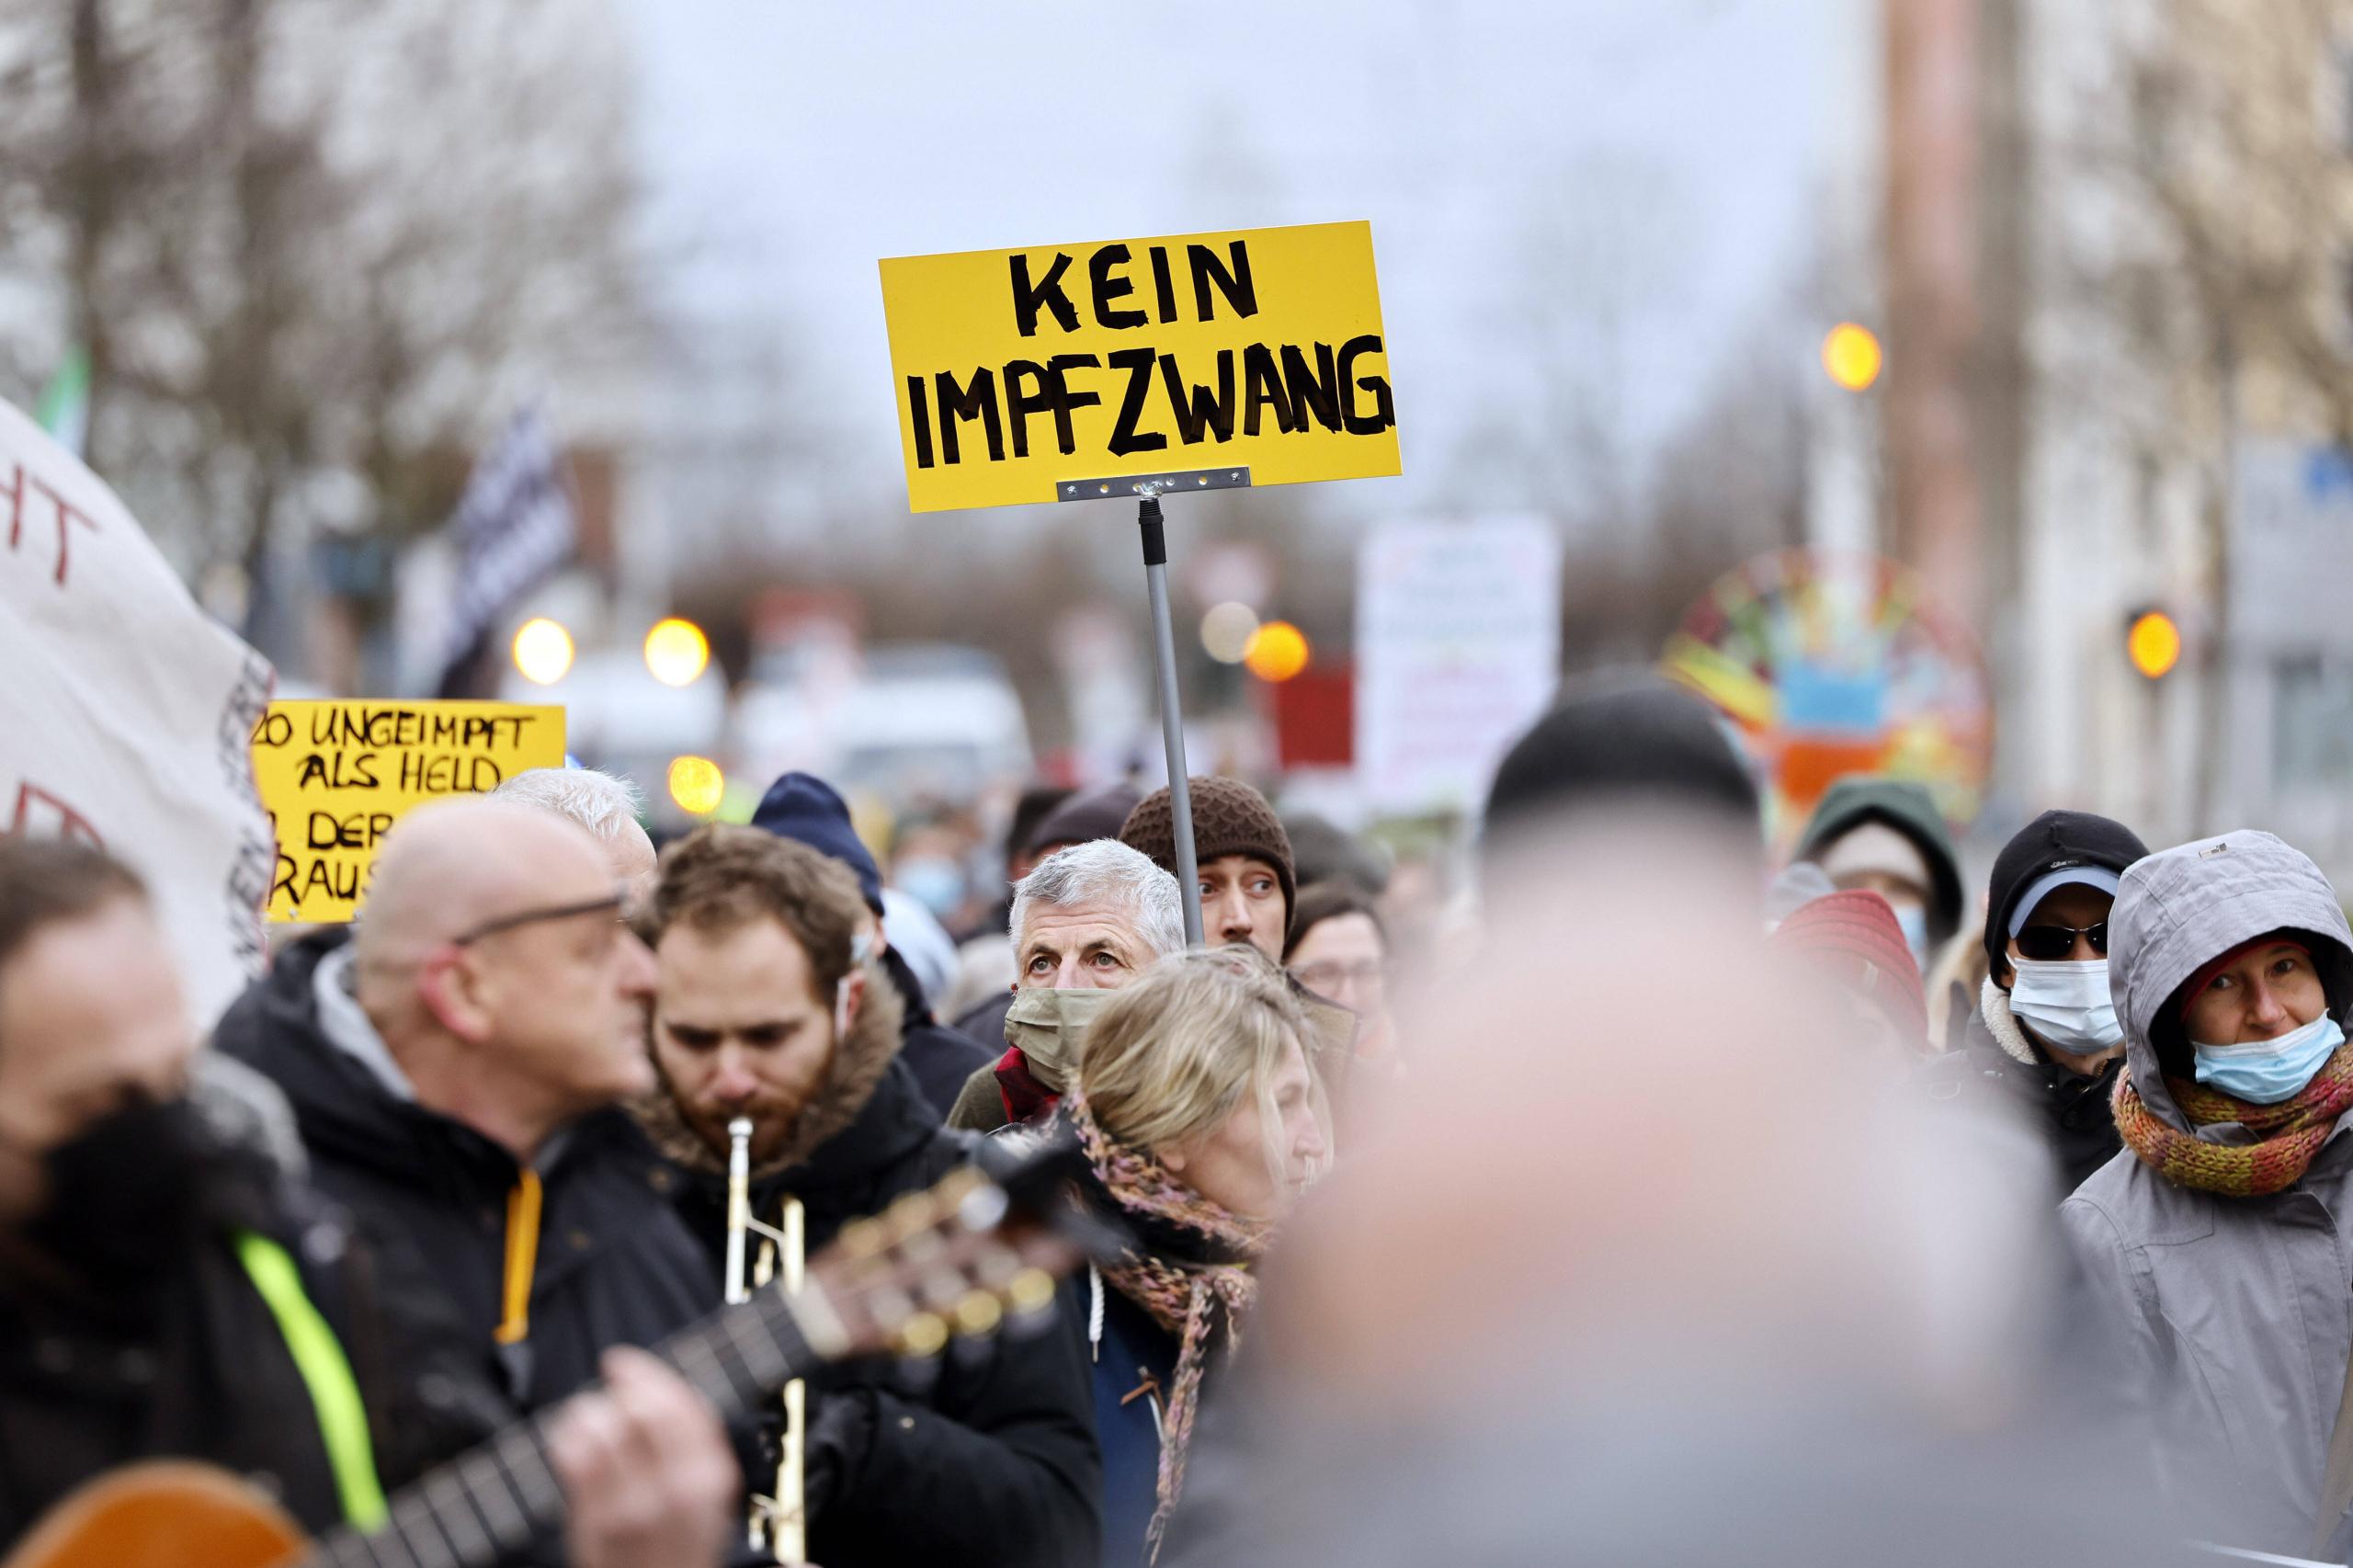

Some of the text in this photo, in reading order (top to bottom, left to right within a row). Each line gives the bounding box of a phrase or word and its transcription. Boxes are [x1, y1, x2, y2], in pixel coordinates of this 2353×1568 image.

[1008, 239, 1259, 337] KEIN
[906, 334, 1396, 469] IMPFZWANG
[311, 706, 537, 750] UNGEIMPFT
[296, 750, 503, 794] ALS HELD
